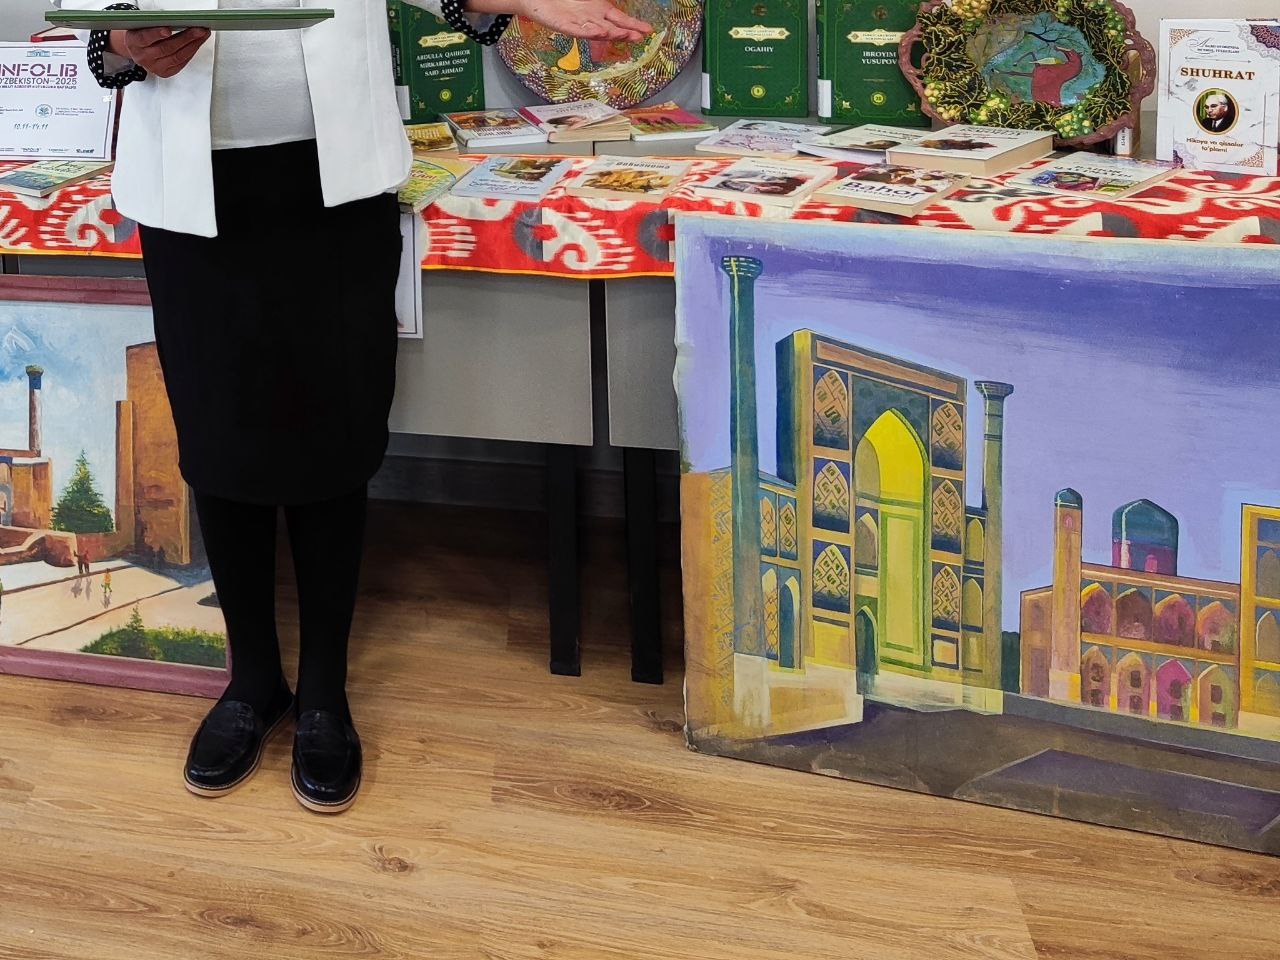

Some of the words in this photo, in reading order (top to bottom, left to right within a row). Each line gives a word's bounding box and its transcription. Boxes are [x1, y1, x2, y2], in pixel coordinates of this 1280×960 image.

[416, 52, 443, 61] ABDULLA
[440, 66, 464, 75] AHMAD
[1180, 67, 1255, 81] SHUHRAT
[1186, 137, 1209, 146] Hikoya
[1218, 140, 1244, 148] qissalar
[843, 181, 926, 197] Bahor
